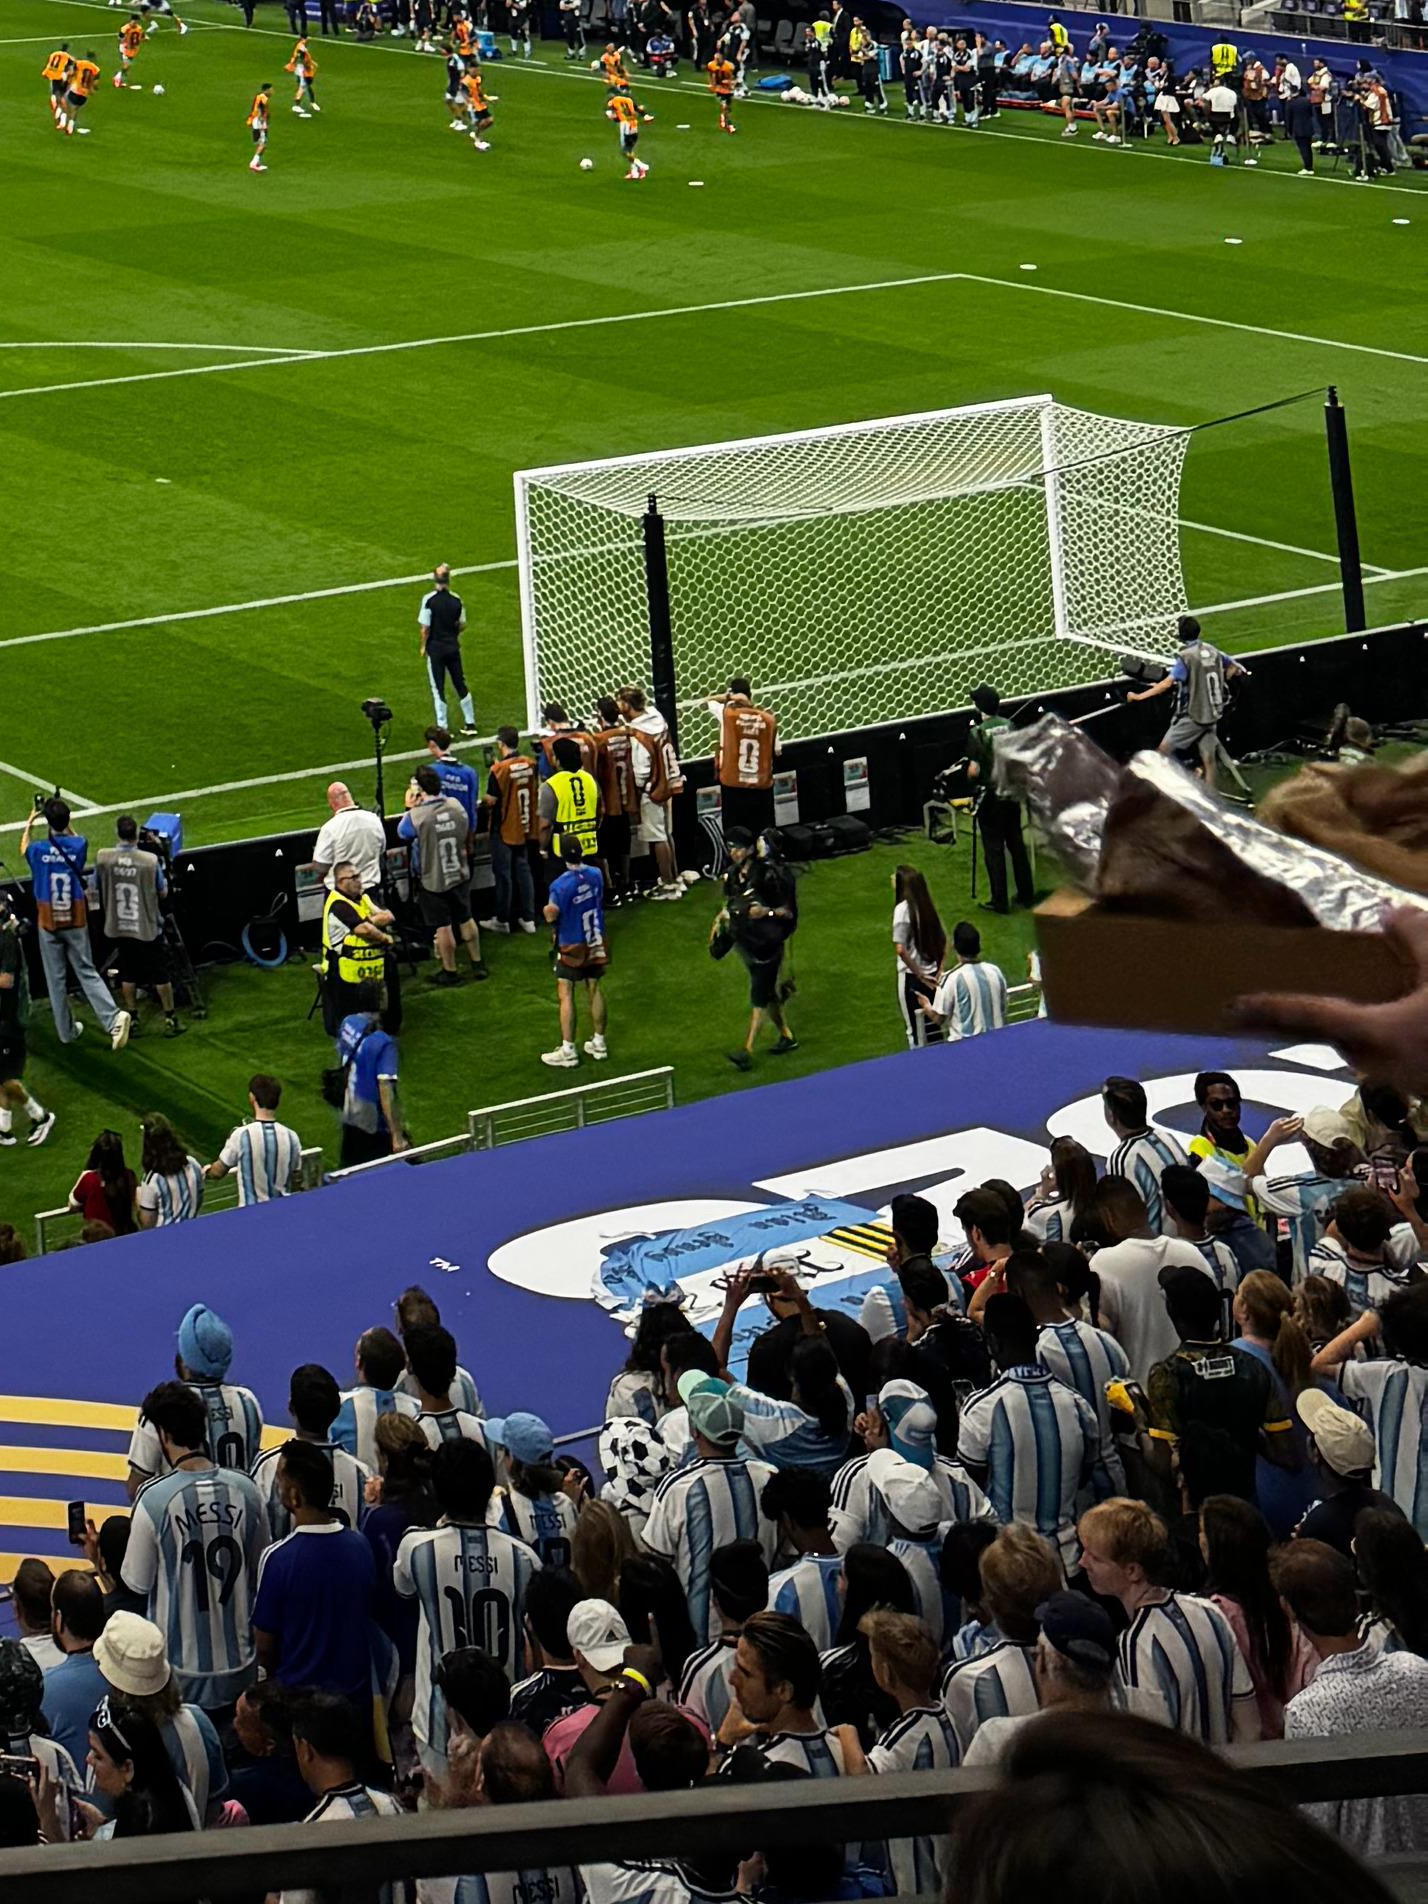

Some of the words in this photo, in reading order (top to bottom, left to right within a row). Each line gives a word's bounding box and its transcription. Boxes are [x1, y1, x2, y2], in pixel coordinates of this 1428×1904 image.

[174, 1500, 243, 1537] MESSI
[181, 1535, 243, 1612] 19
[454, 1554, 499, 1578] MESSI
[444, 1585, 510, 1670] 10
